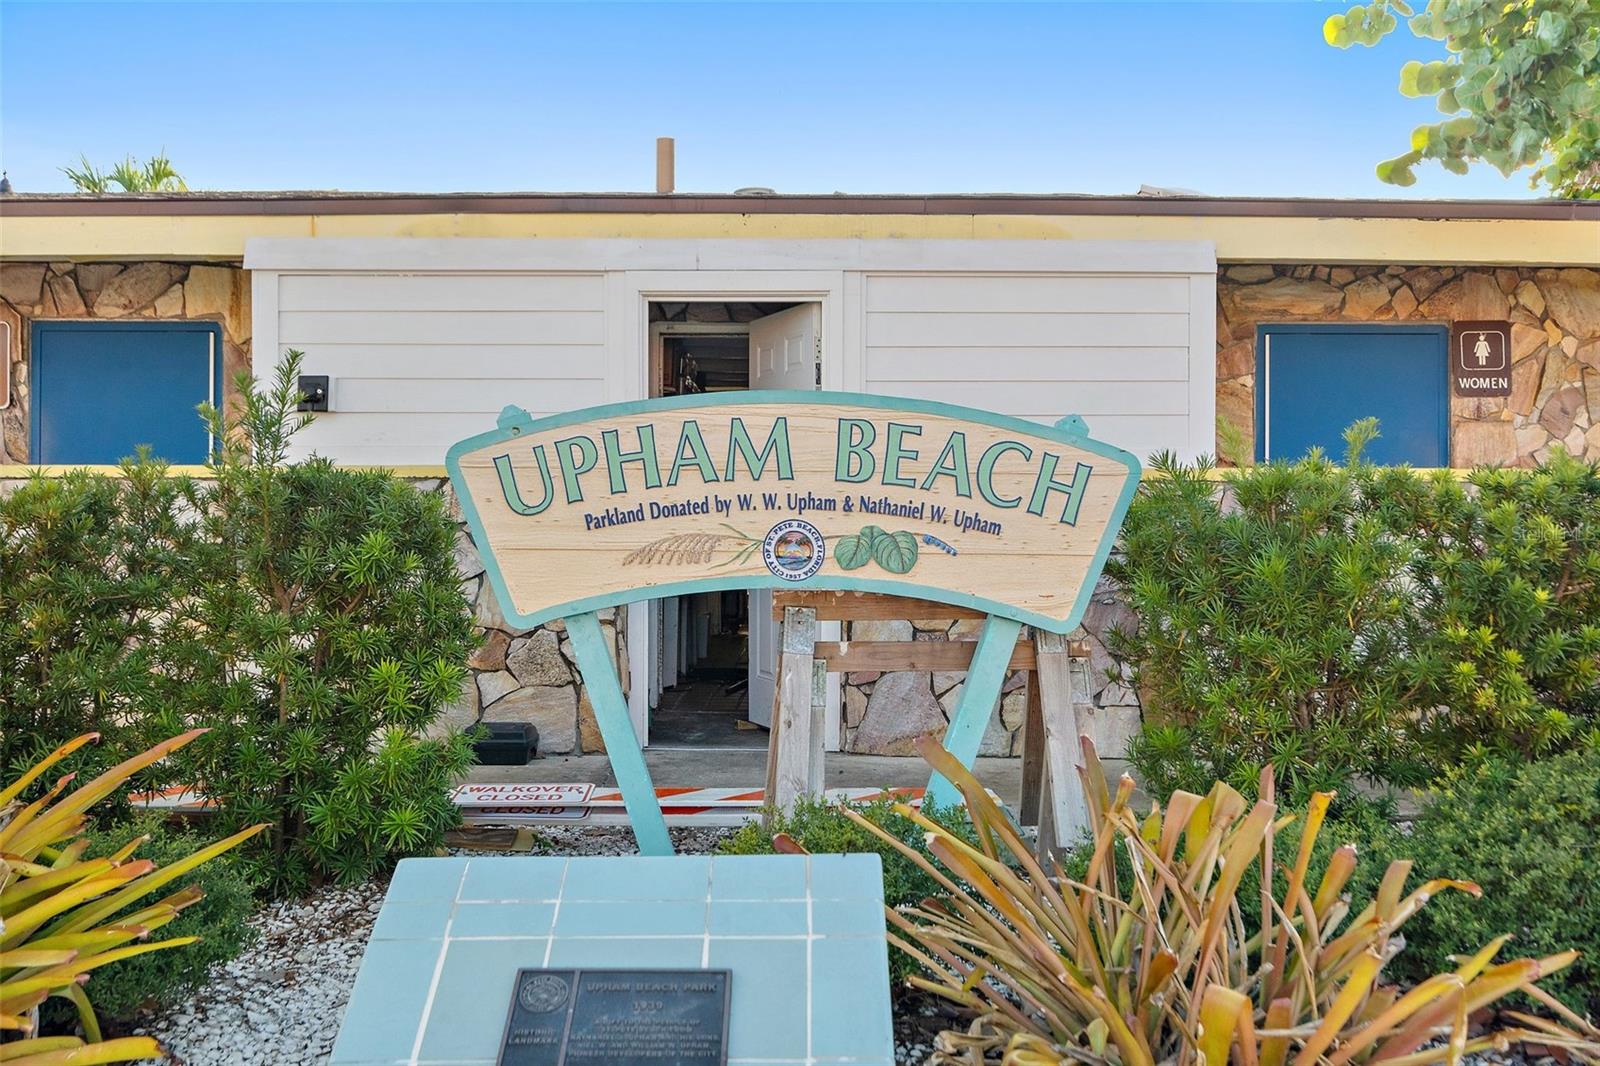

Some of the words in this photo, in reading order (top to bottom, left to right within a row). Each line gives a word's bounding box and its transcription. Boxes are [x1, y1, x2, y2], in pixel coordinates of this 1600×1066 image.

[1458, 377, 1508, 389] WOMEN
[492, 416, 794, 516] UPHAM
[834, 417, 1094, 527] BEACH
[584, 502, 645, 531] Parkland
[649, 495, 710, 521] Donated
[714, 495, 731, 517] by
[737, 493, 757, 511] W.
[762, 492, 782, 510] W.
[786, 493, 836, 515] Upham
[842, 494, 855, 512] &
[859, 495, 924, 520] Nathaniel
[930, 507, 947, 525] W.
[953, 509, 1002, 536] Upham
[773, 522, 793, 535] PETE
[766, 535, 775, 547] ST.
[765, 548, 772, 560] OF
[803, 545, 823, 576] FLORIDA
[768, 561, 784, 577] CITY
[480, 806, 566, 815] CLOSED
[586, 982, 631, 993] UPHAM
[635, 982, 678, 993] BEACH
[682, 982, 717, 993] PARK
